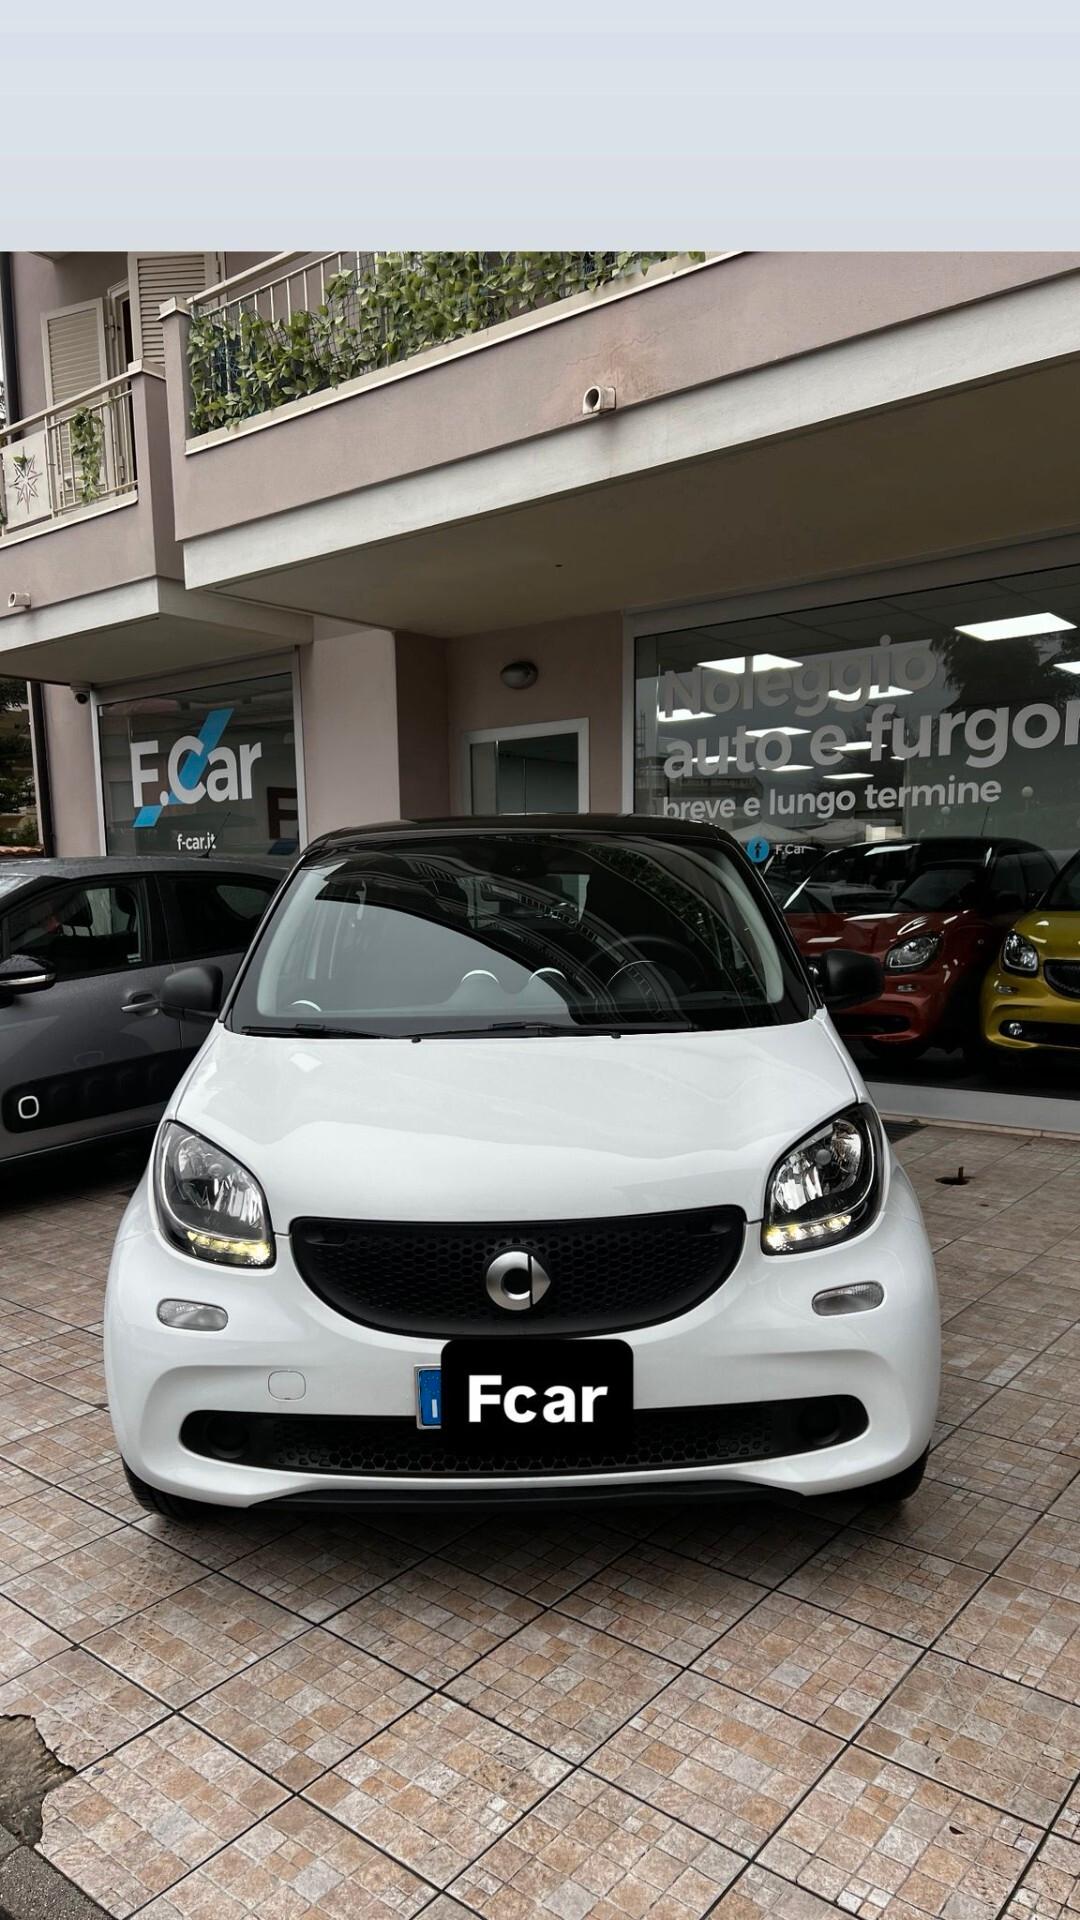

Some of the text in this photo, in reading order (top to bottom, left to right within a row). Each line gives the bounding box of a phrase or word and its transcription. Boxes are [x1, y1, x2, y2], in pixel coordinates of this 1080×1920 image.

[664, 634, 938, 719] Noleggio
[129, 735, 263, 808] F.Car
[663, 725, 793, 780] auto
[809, 724, 848, 766] e
[663, 774, 1002, 819] breve e lungo termine
[176, 831, 217, 851] f-car.it
[774, 843, 806, 856] F.Car
